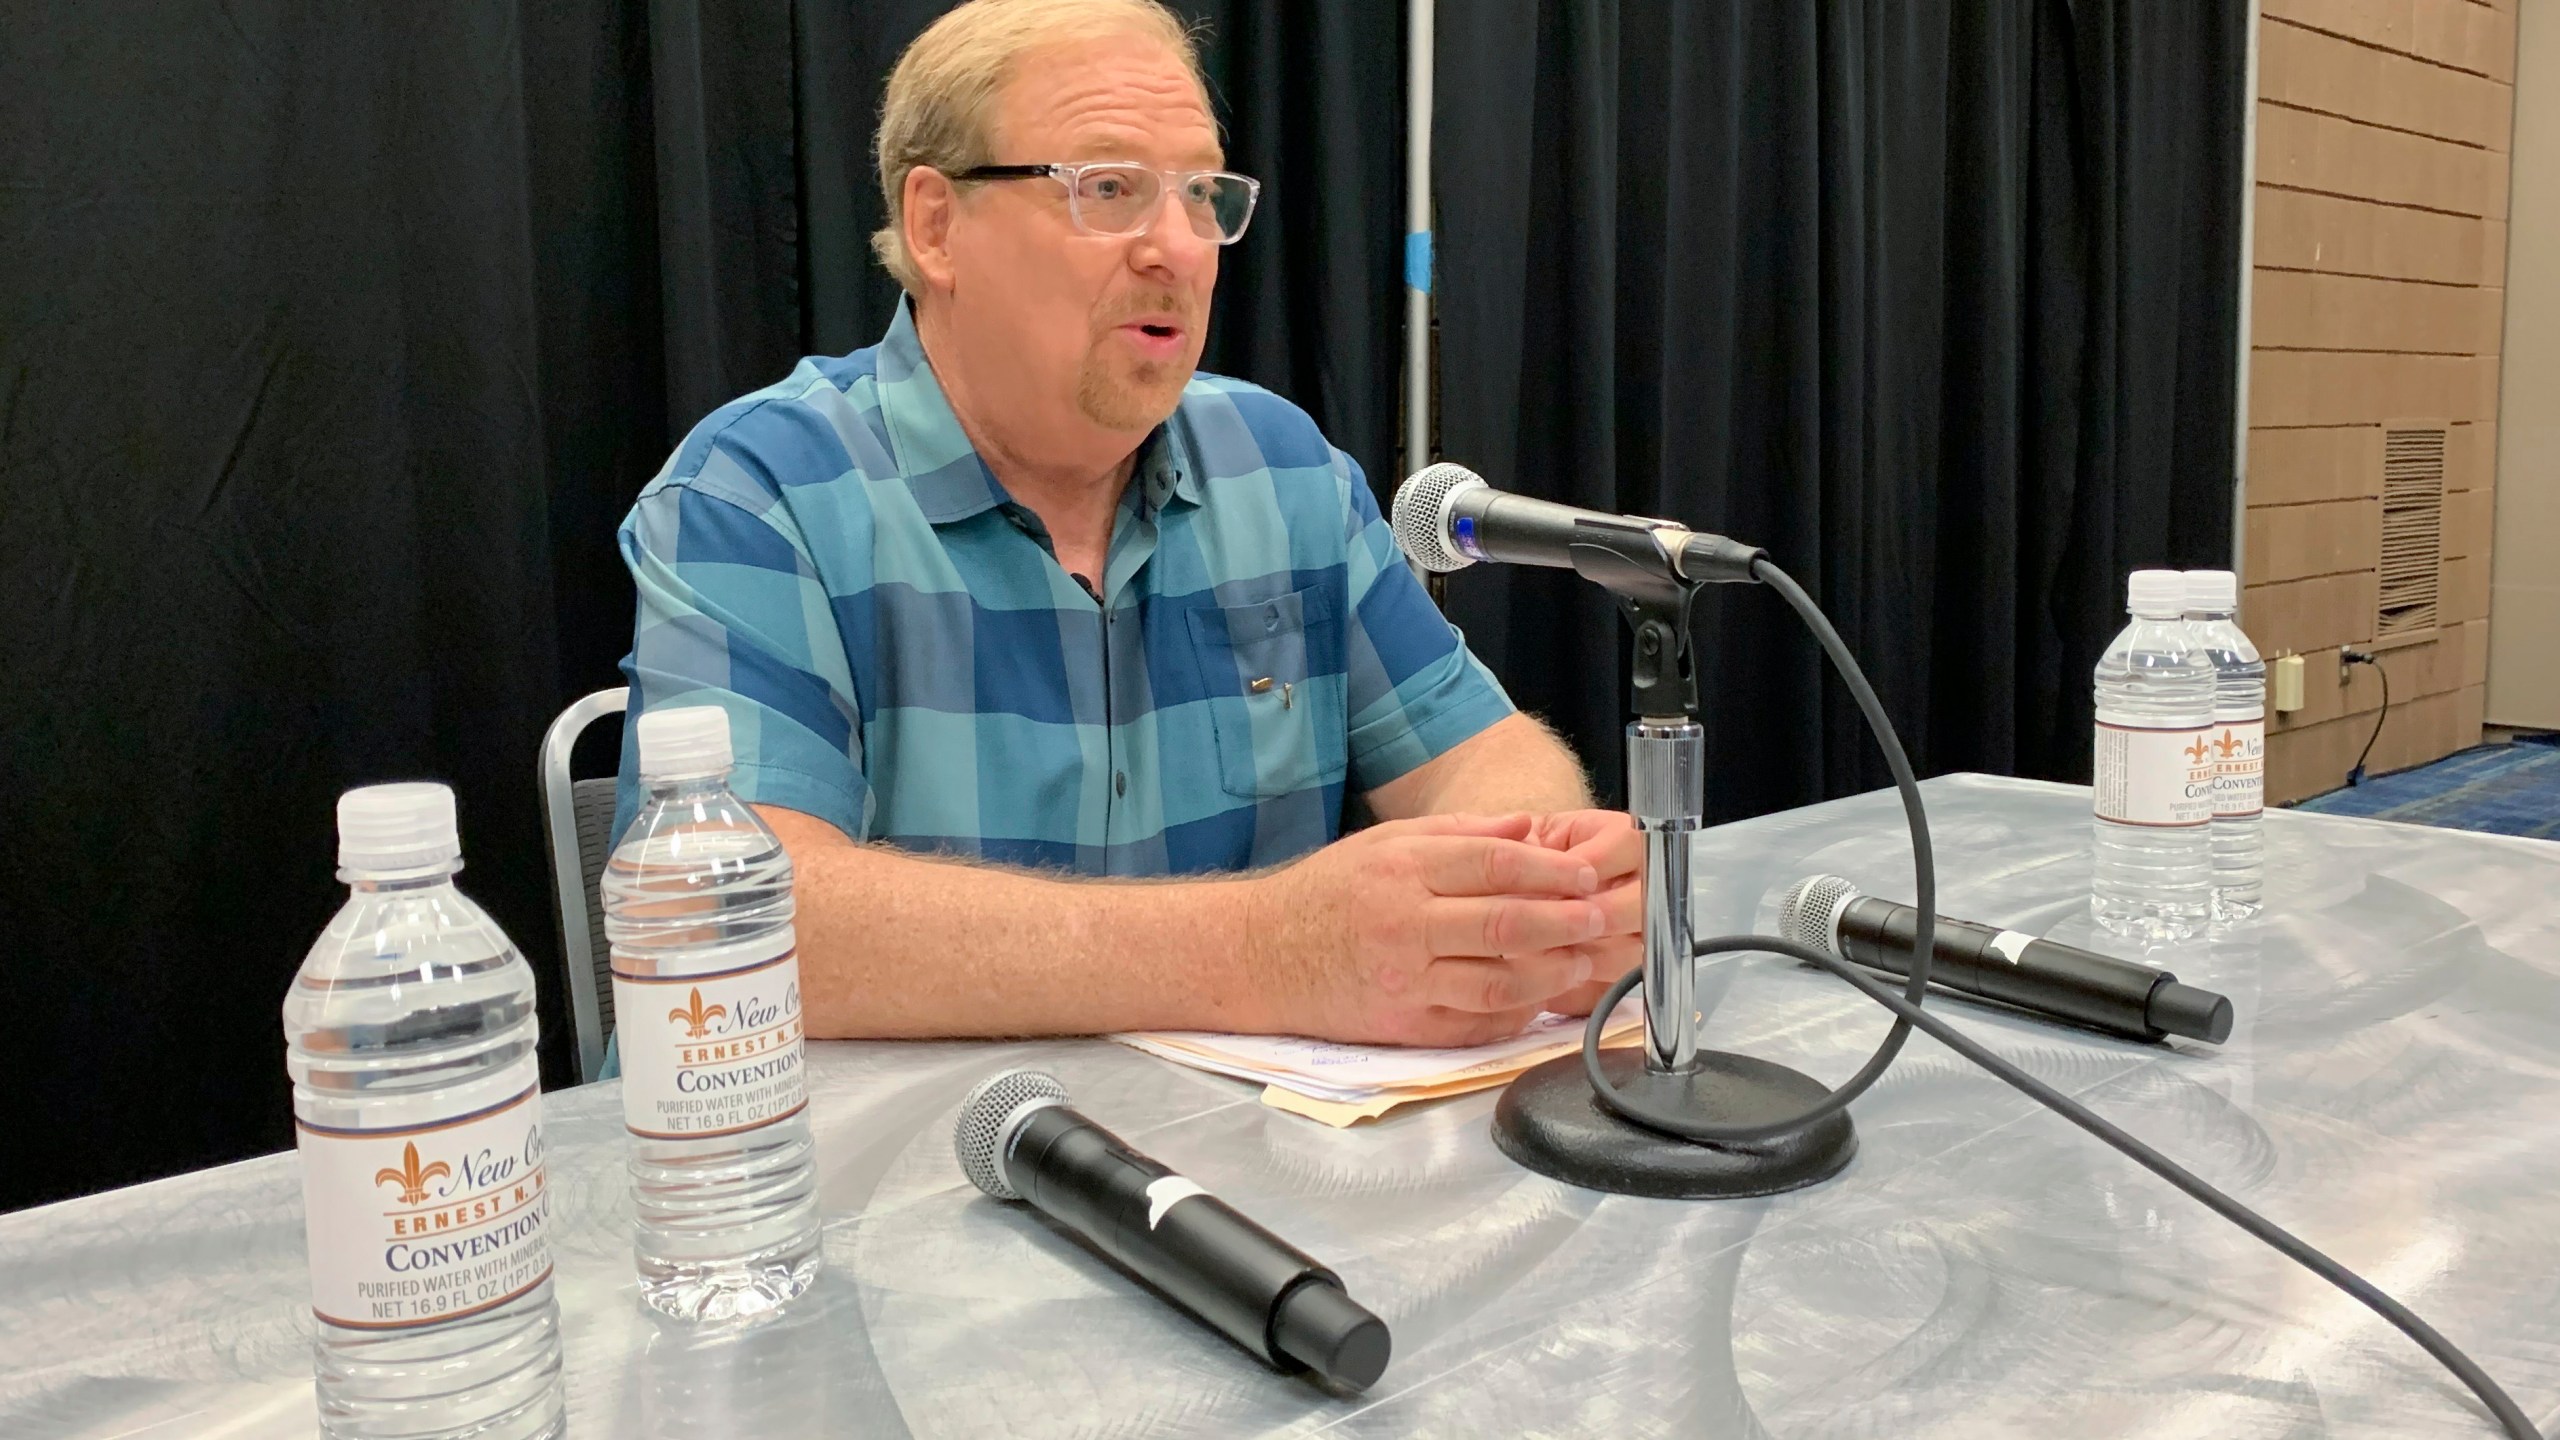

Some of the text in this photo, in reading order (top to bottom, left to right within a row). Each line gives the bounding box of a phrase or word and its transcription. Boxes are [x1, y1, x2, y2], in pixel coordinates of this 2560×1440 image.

[2216, 762, 2258, 772] ERNEST
[717, 996, 780, 1034] New
[683, 1036, 767, 1063] ERNEST
[777, 1029, 788, 1044] N.
[656, 1099, 703, 1114] PURIFIED
[705, 1093, 744, 1112] WATER
[745, 1085, 772, 1105] WITH
[667, 1115, 691, 1131] NET
[696, 1113, 725, 1130] 16.9
[728, 1110, 744, 1125] FL
[747, 1104, 764, 1121] OZ
[767, 1094, 789, 1119] (1PT
[438, 1148, 519, 1198] New
[394, 1196, 501, 1235] ERNEST
[514, 1186, 529, 1204] N.
[357, 1279, 420, 1299] PURIFIED
[422, 1268, 473, 1294] WATER
[474, 1254, 508, 1281] WITH
[371, 1300, 404, 1319] NET
[410, 1294, 447, 1316] 16.9
[452, 1289, 473, 1308] FL
[476, 1279, 499, 1301] OZ
[502, 1263, 530, 1295] (1PT
